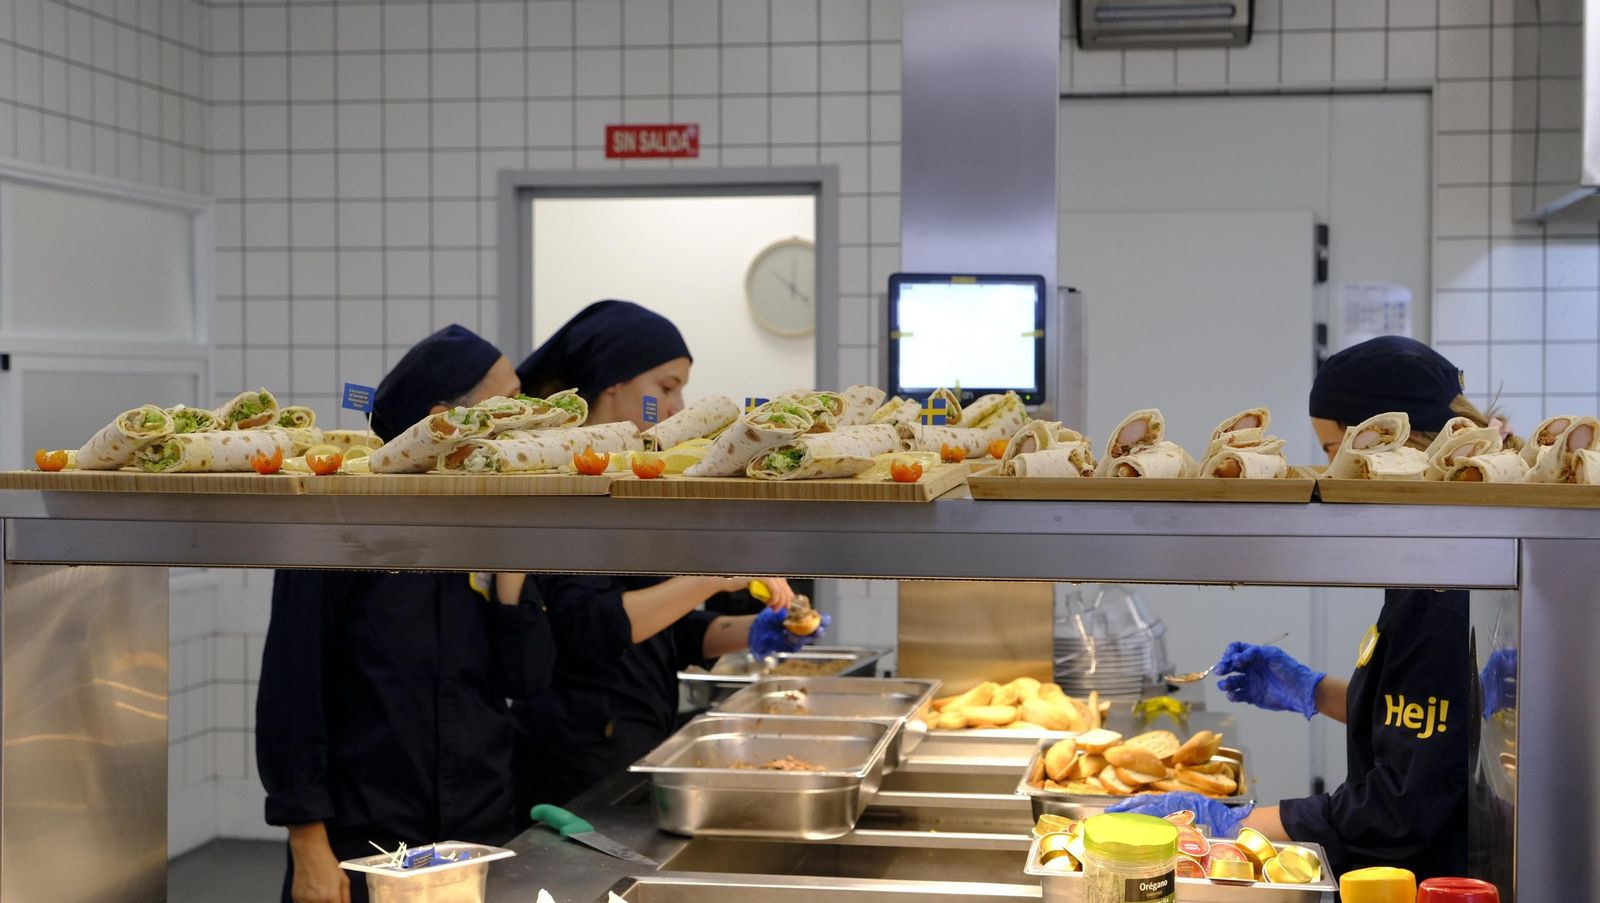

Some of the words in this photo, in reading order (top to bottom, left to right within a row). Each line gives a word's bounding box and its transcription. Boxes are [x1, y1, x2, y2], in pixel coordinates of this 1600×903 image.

[612, 130, 636, 153] SIN
[638, 130, 690, 153] SALIDA
[1384, 694, 1449, 739] Hej!
[1139, 879, 1168, 891] Orégano
